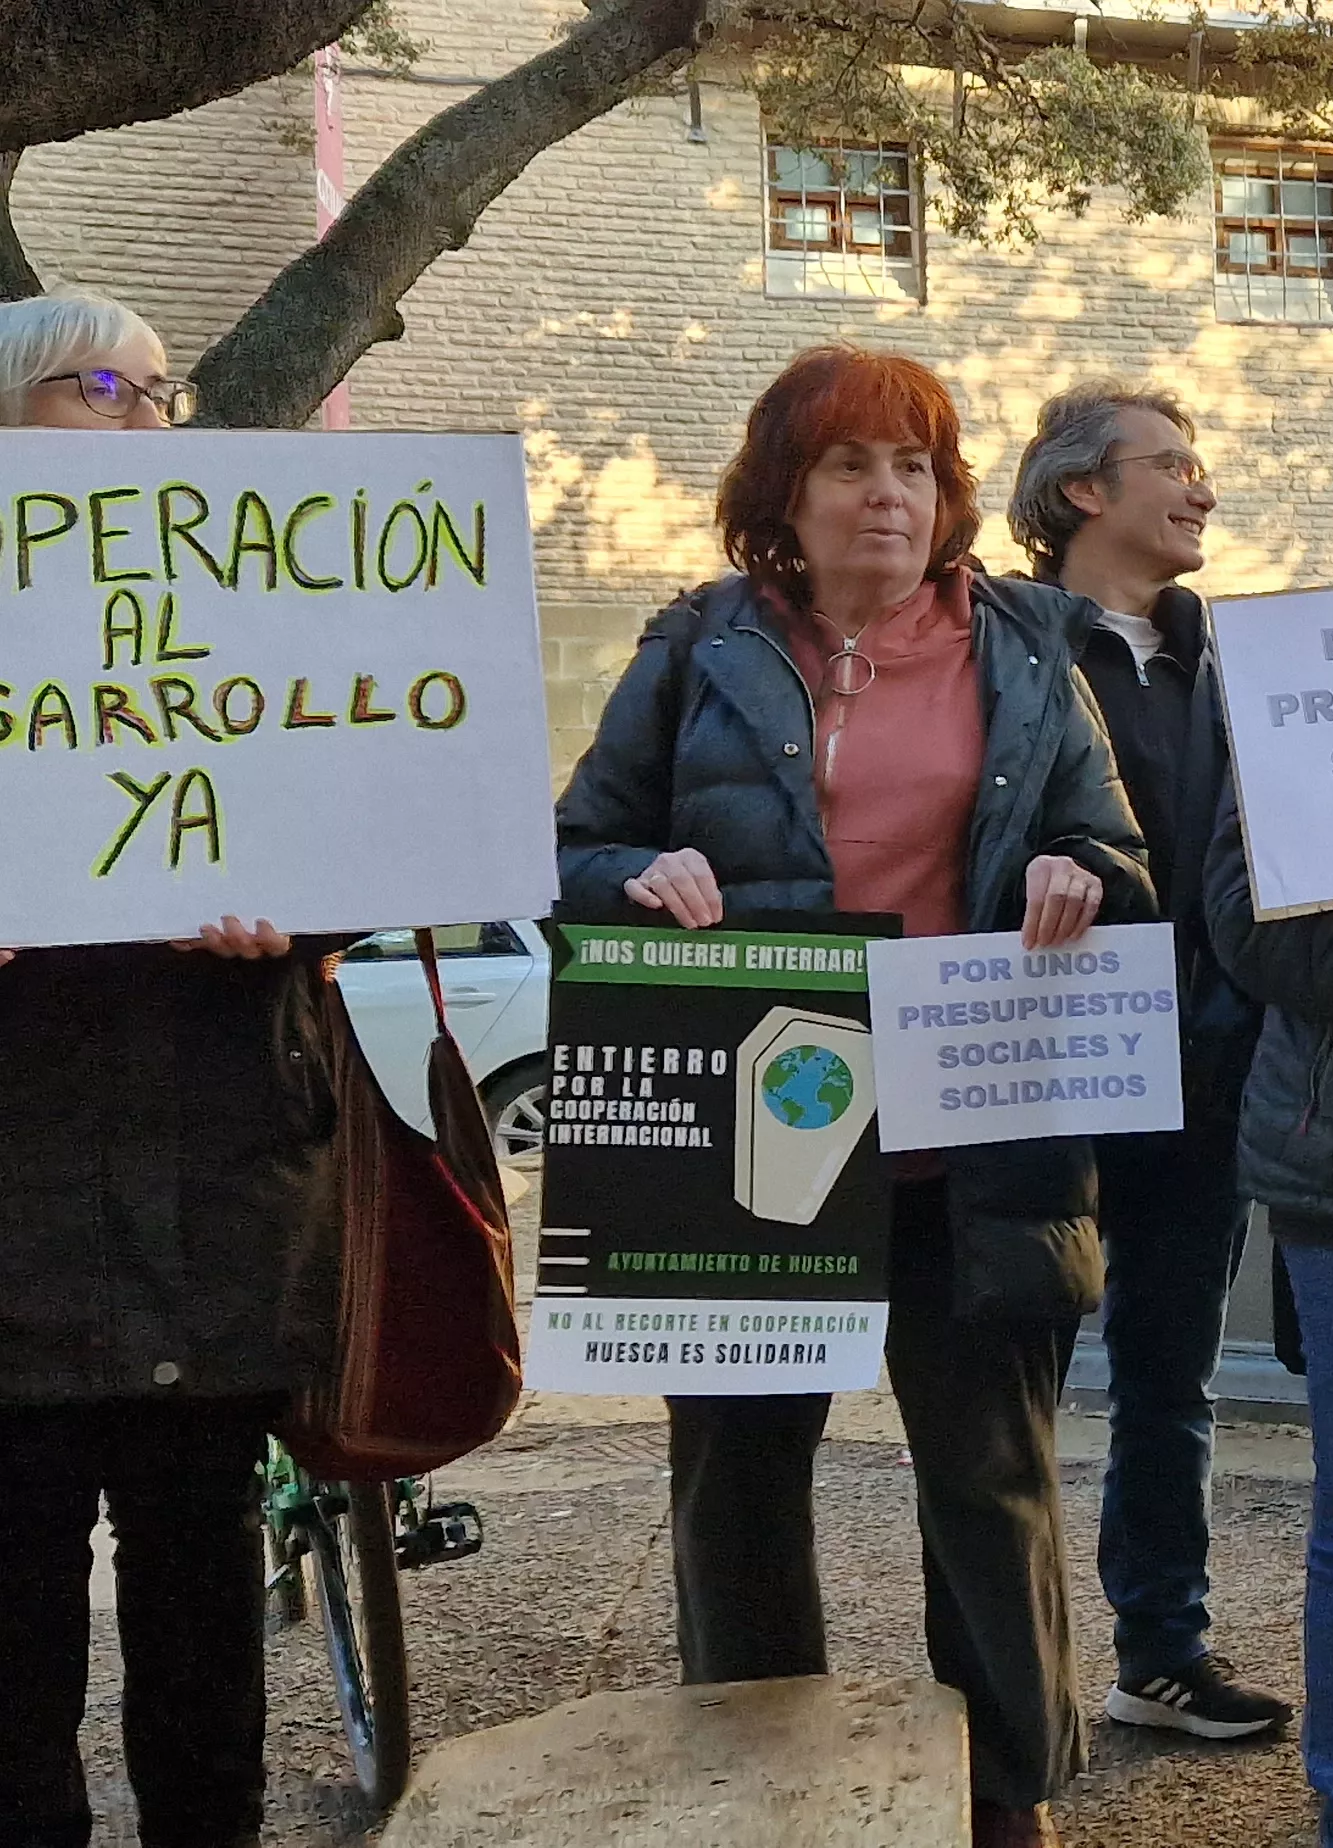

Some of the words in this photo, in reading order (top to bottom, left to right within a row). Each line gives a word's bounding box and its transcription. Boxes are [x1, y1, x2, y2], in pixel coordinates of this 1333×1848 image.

[0, 479, 489, 592] PERACIÓN
[101, 588, 213, 671] AL
[95, 768, 221, 878] YA
[579, 938, 634, 966] ¡NOS
[642, 940, 737, 970] QUIEREN
[745, 946, 865, 973] ENTERRAR!
[939, 958, 1013, 986] POR
[1022, 949, 1120, 978] UNOS
[897, 988, 1174, 1031] PRESUPUESTOS
[553, 1044, 728, 1076] ENTIERRO
[937, 1032, 1109, 1069] SOCIALES
[1118, 1031, 1143, 1057] Y
[551, 1076, 605, 1098] POR
[621, 1076, 653, 1098] LA
[938, 1073, 1147, 1112] SOLIDARIOS
[550, 1097, 697, 1124] COOPERACIÓN
[548, 1124, 713, 1148] INTERNACIONAL
[607, 1251, 750, 1273] AYUNTAMIENTO
[757, 1253, 779, 1274] DE
[788, 1253, 859, 1275] HUESCA
[547, 1310, 573, 1330] NO
[582, 1311, 605, 1331] AL
[614, 1312, 701, 1332] RECORTE
[707, 1312, 731, 1333] EN
[739, 1310, 870, 1334] COOPERACIÓN
[585, 1340, 669, 1365] HUESCA
[679, 1342, 704, 1365] ES
[714, 1342, 828, 1366] SOLIDARIA
